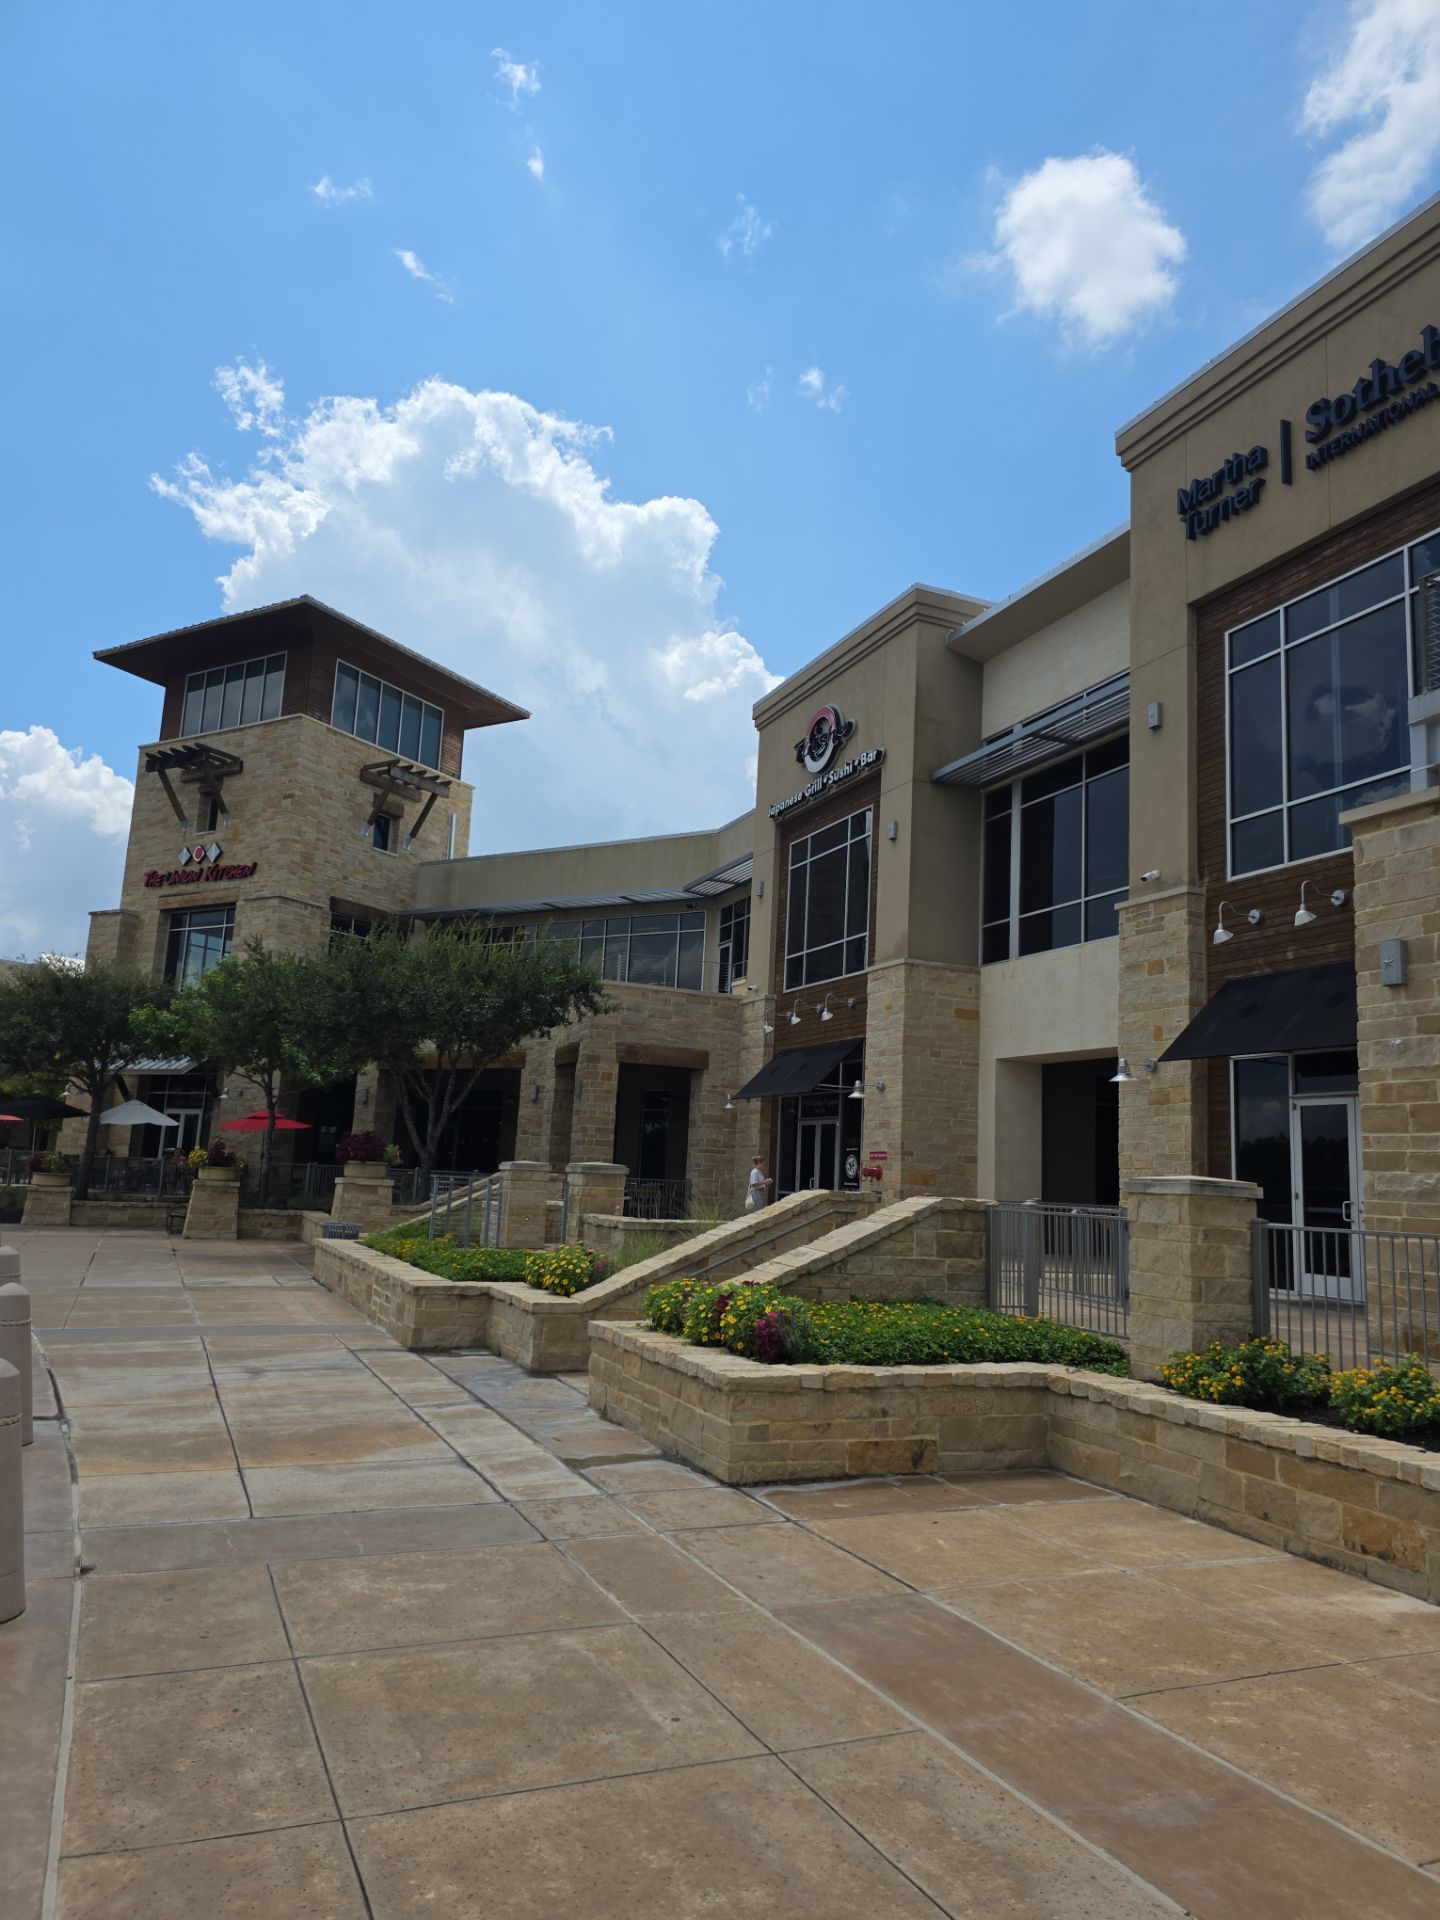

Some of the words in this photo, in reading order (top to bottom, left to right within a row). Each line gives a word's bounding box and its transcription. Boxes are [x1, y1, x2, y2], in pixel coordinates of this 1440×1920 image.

[1306, 381, 1440, 471] INTERNATIONAL
[1177, 445, 1268, 515] Martha
[1180, 477, 1266, 541] Turner
[768, 791, 803, 817] Japanese
